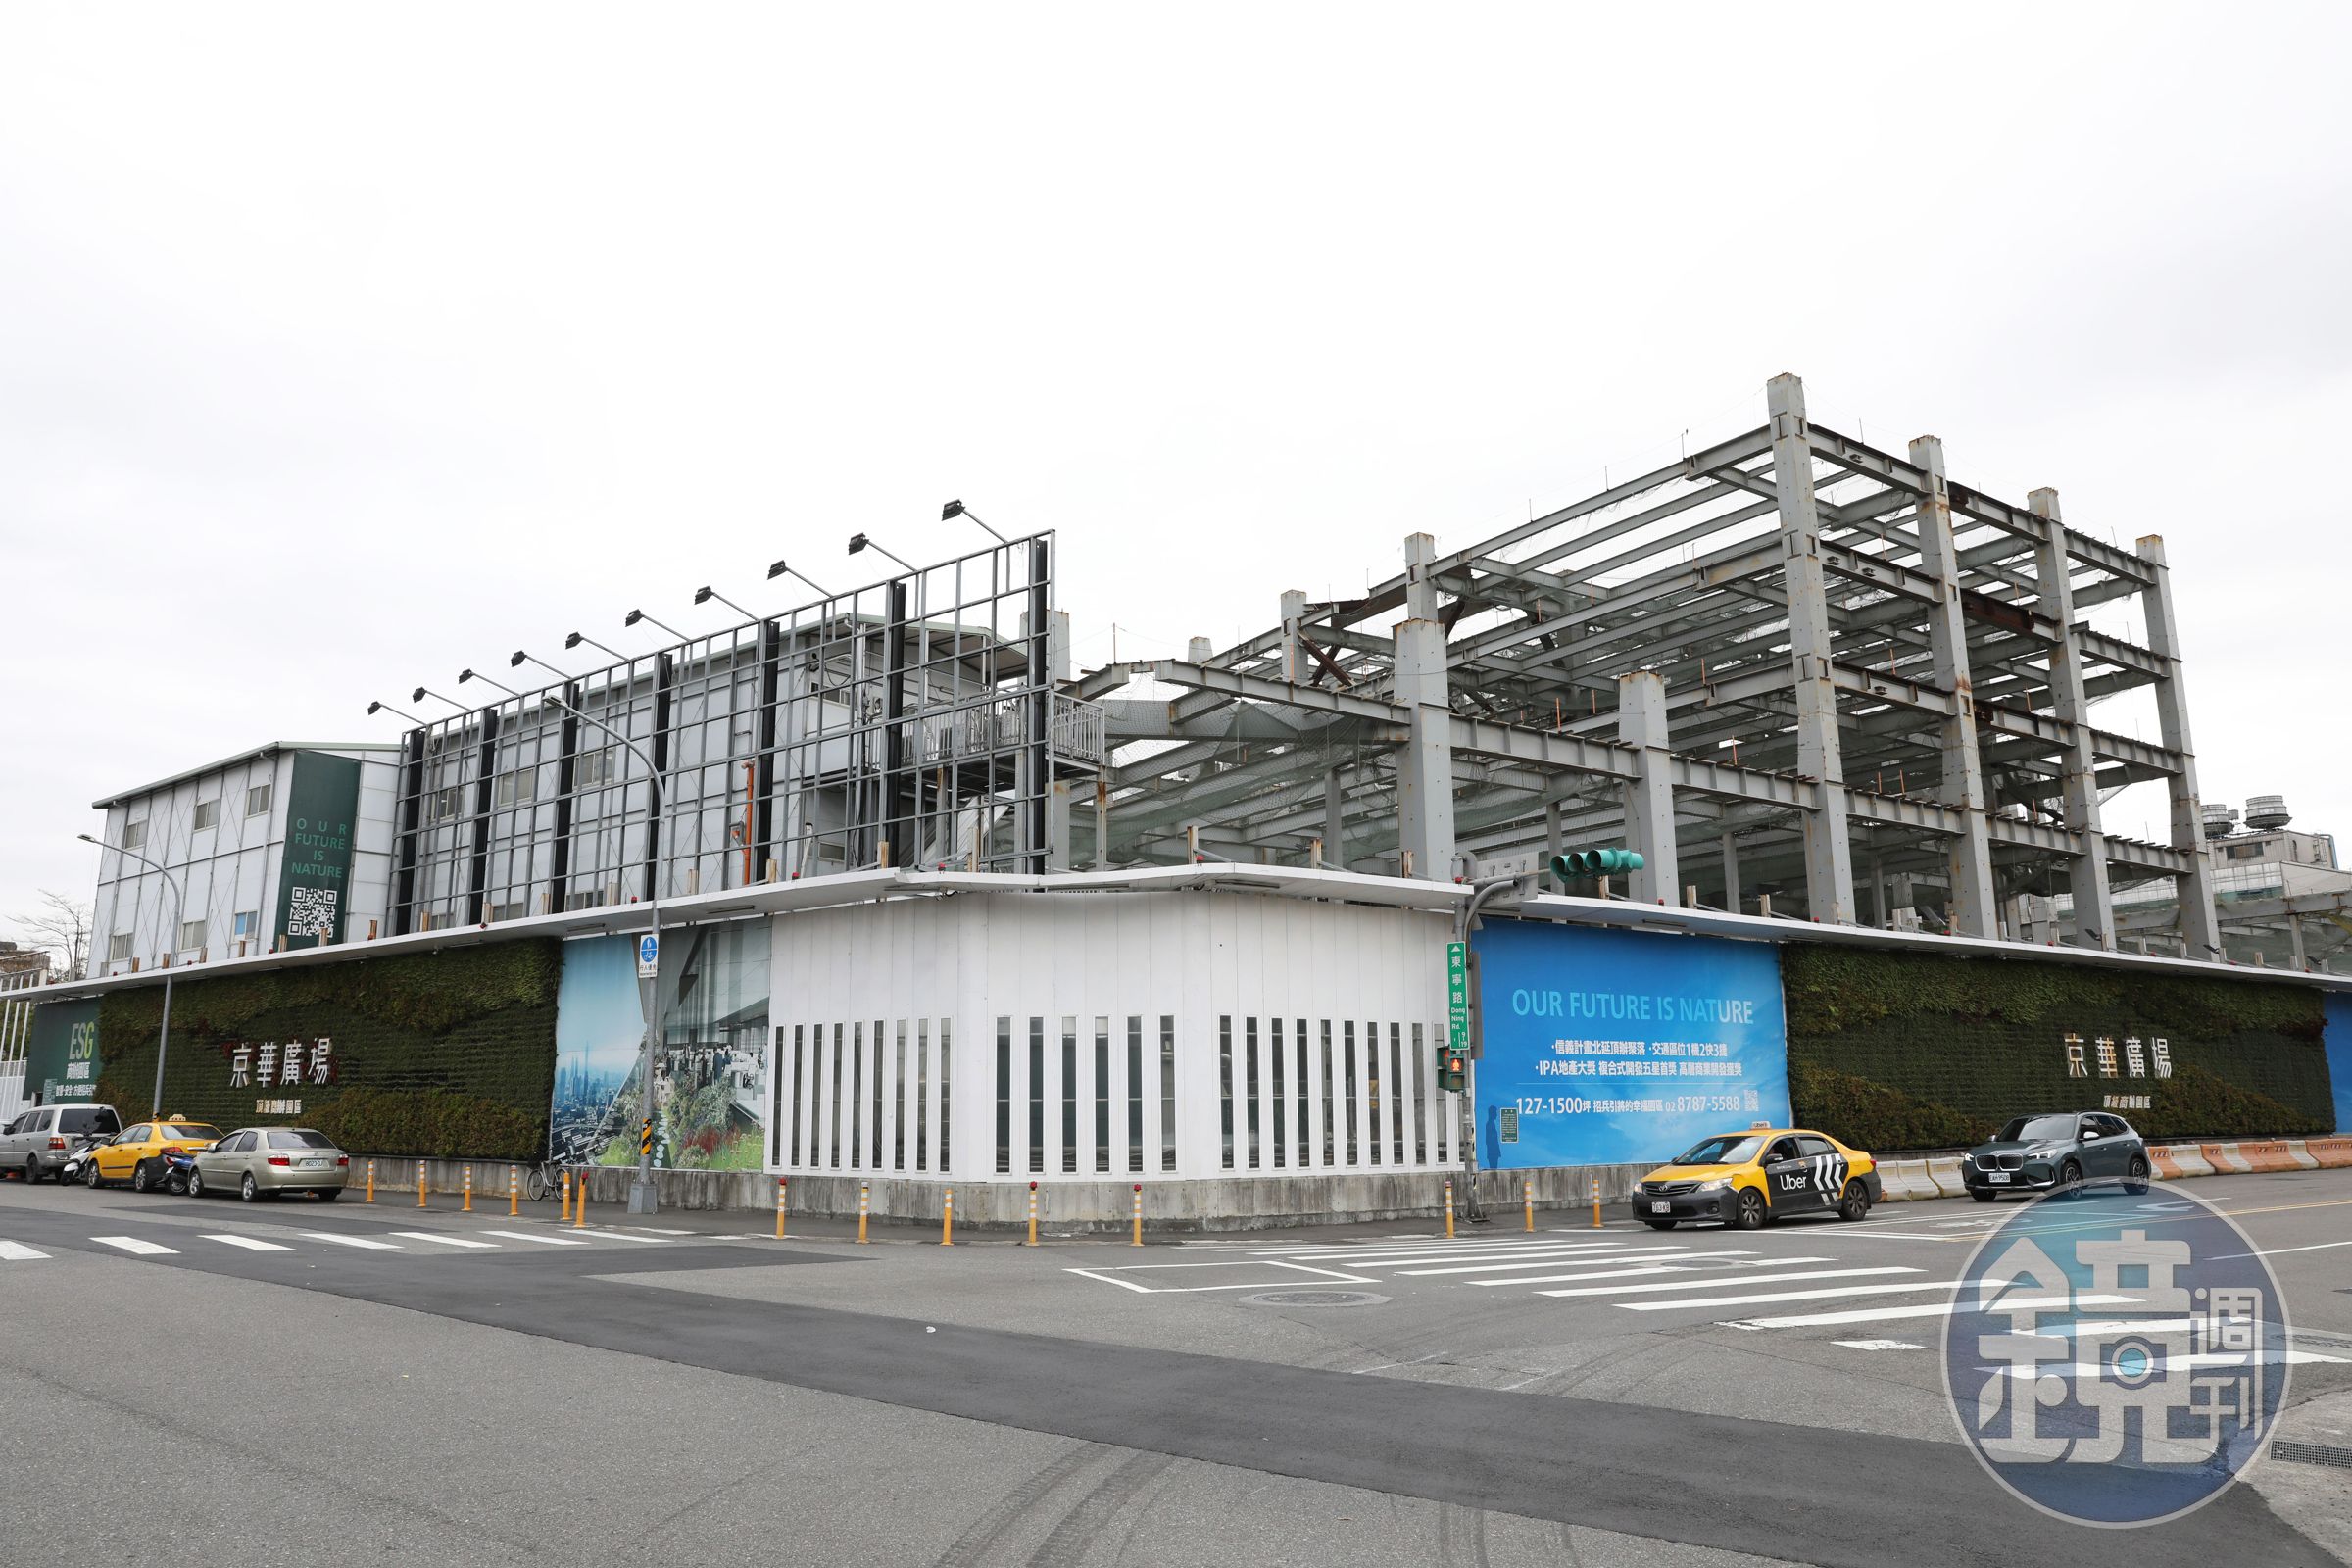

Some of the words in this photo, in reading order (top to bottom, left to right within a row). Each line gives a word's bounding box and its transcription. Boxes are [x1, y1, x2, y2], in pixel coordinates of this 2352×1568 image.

[295, 833, 345, 849] FUTURE
[313, 850, 324, 861] IS
[291, 862, 343, 878] NATURE
[1451, 956, 1463, 1004] 東寧路
[1512, 988, 1563, 1016] OUR
[1570, 992, 1650, 1020] FUTURE
[1657, 996, 1675, 1021] IS
[1680, 998, 1753, 1025] NATURE
[69, 1021, 95, 1059] ESG
[229, 1037, 331, 1088] 京華廣場
[2063, 1032, 2173, 1079] 京華廣場
[1516, 1097, 1592, 1114] 127-1500坪
[1665, 1102, 1676, 1112] 02
[1677, 1096, 1740, 1113] 8787-5588
[1780, 1174, 1807, 1191] Uber
